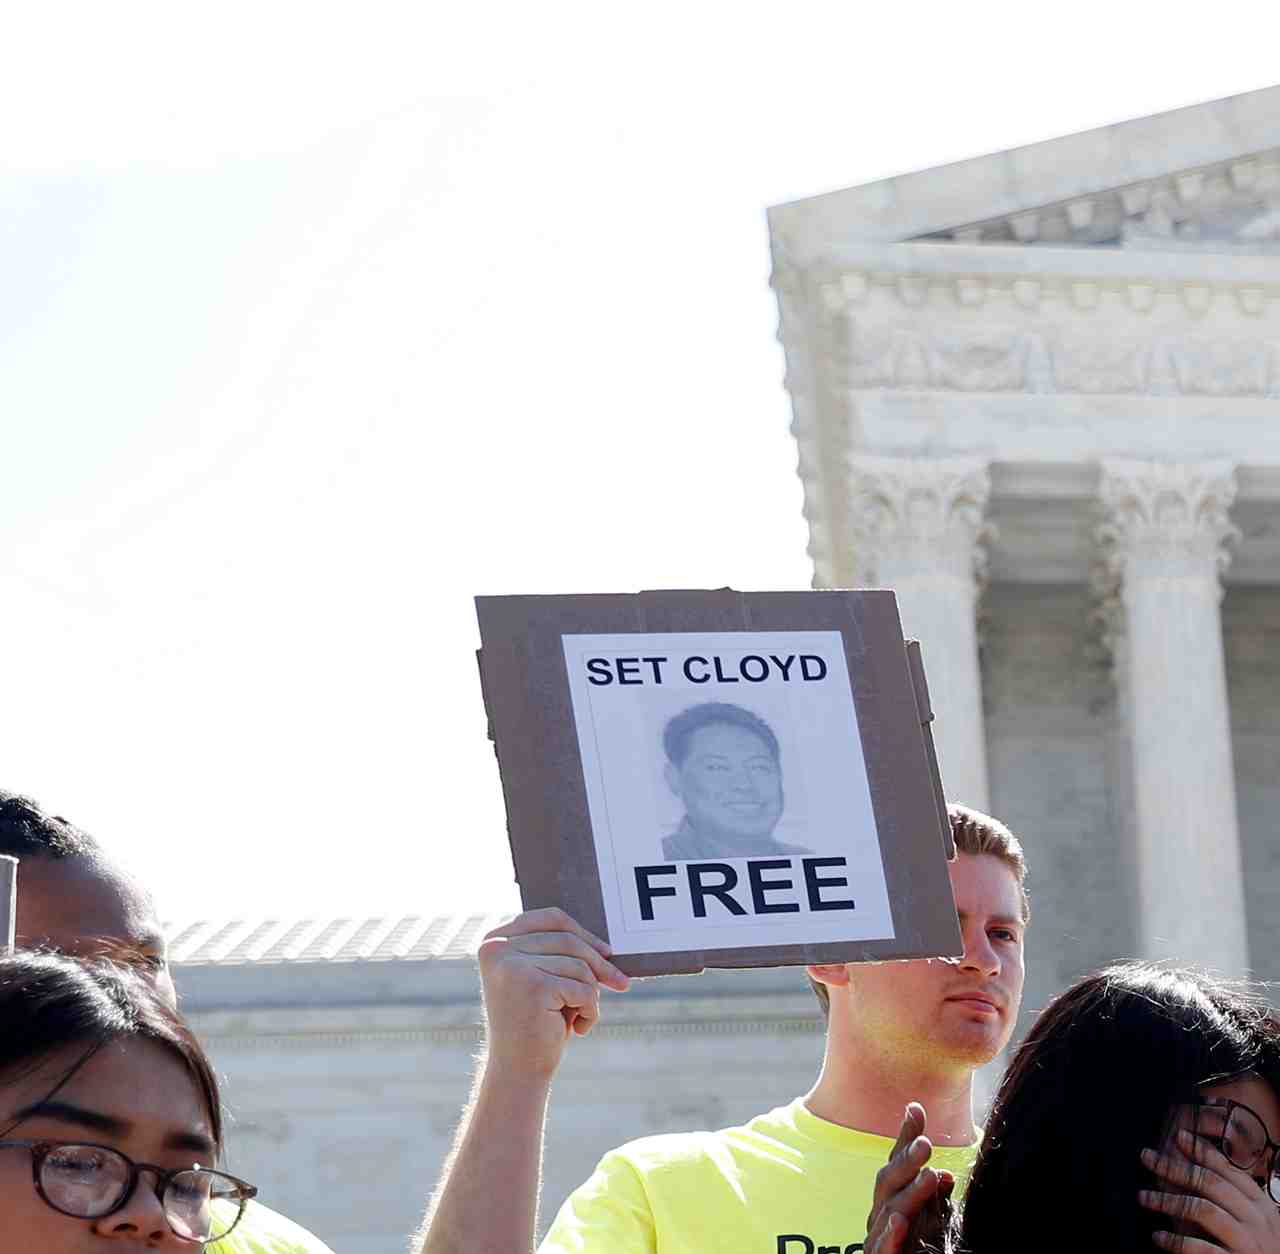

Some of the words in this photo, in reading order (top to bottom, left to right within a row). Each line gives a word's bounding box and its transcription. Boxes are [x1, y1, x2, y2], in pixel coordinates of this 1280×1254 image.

[587, 657, 668, 686] SET
[684, 655, 827, 684] CLOYD
[634, 857, 856, 920] FREE
